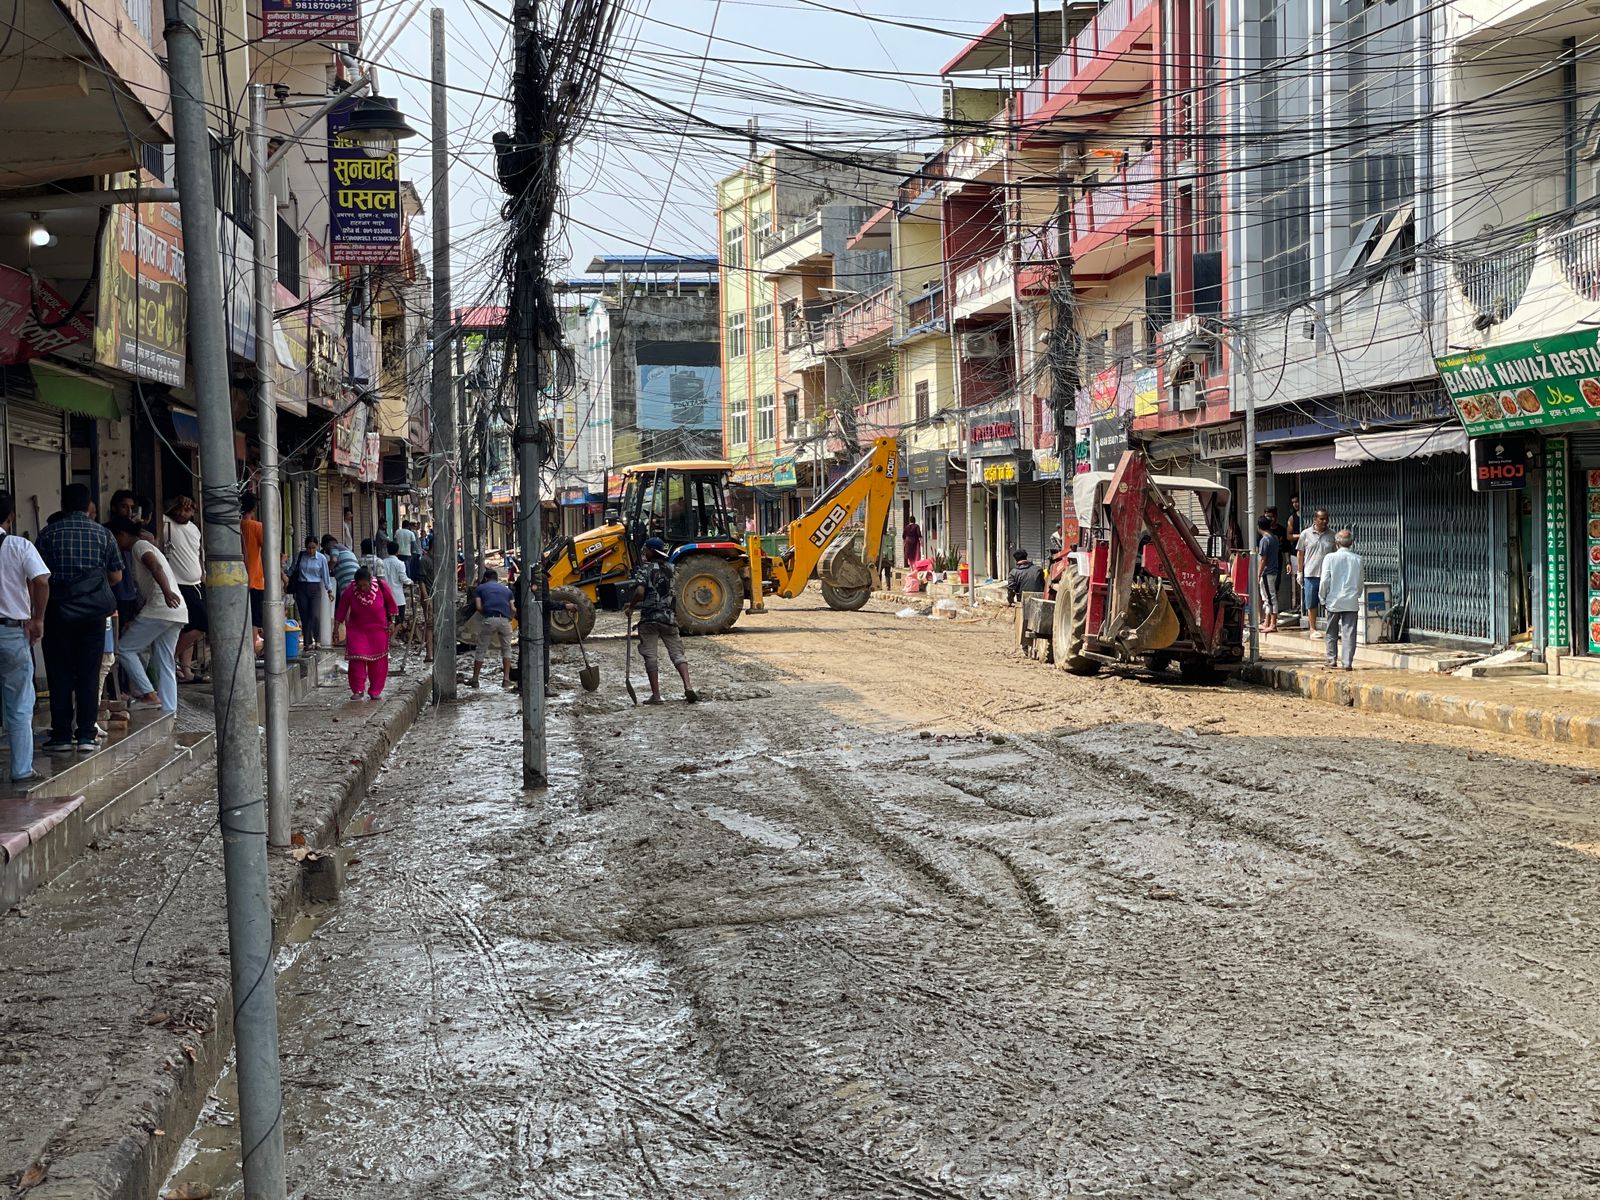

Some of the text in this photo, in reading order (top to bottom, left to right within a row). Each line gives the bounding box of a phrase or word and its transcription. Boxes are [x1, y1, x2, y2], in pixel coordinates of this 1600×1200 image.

[338, 190, 398, 210] पसल
[1443, 364, 1497, 394] BANDA
[1494, 354, 1554, 386] NAWAZ
[1546, 384, 1575, 406] حلال
[1478, 464, 1524, 480] BHOJ
[1555, 451, 1563, 496] BANDA
[814, 505, 846, 547] JCB
[1556, 503, 1565, 548] NAWAZ
[583, 542, 603, 555] JCB
[1558, 554, 1566, 645] RESTAURANT
